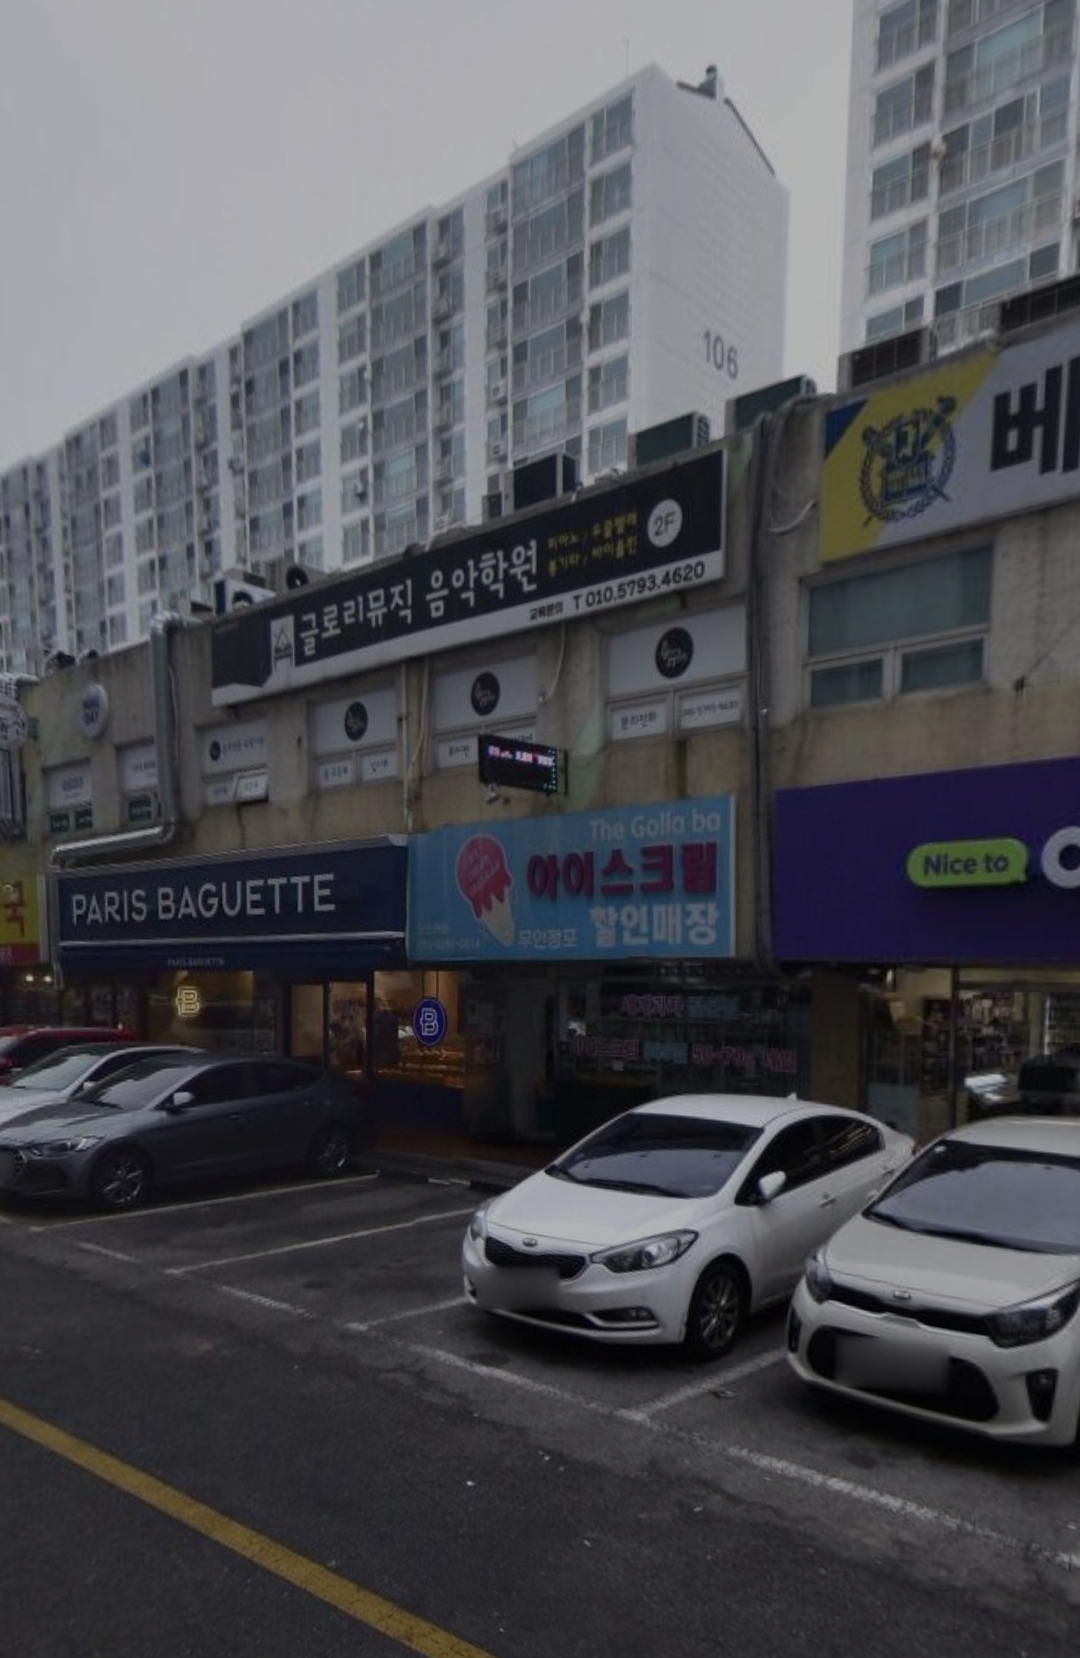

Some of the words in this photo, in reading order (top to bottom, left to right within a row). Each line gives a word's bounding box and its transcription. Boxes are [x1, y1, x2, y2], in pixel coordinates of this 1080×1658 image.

[703, 329, 739, 380] 106
[653, 510, 677, 537] 2F
[299, 579, 413, 657] 글로리뮤직
[425, 538, 538, 619] 음악학원
[572, 595, 583, 611] T
[585, 560, 706, 607] 010.5793.4620
[589, 817, 625, 842] The
[527, 840, 718, 902] 아이스크림
[923, 852, 977, 876] Nice
[984, 853, 1009, 873] to
[71, 888, 148, 925] PARIS
[156, 873, 337, 920] BAGUETTE
[517, 928, 578, 949] 무인점포
[589, 901, 720, 948] 할인매장
